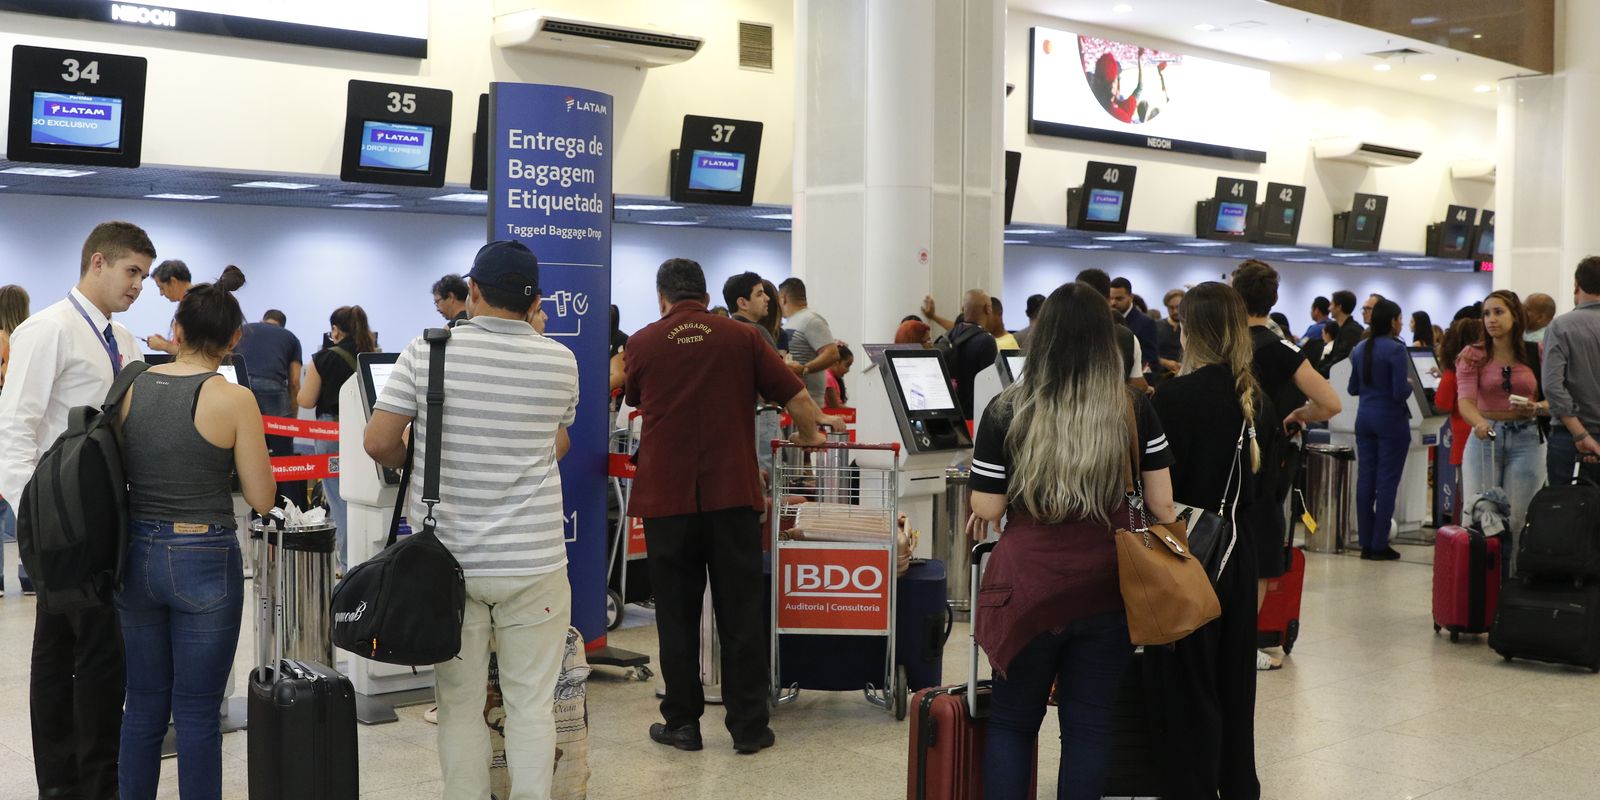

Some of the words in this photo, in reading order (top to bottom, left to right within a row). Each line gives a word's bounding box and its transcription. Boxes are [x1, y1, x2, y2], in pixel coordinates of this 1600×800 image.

[61, 58, 100, 84] 34
[387, 91, 417, 114] 35
[577, 101, 608, 115] LATAM
[62, 106, 105, 116] LATAM
[47, 119, 98, 129] EXCLUSIVO
[385, 133, 419, 142] LATAM
[711, 124, 736, 143] 37
[366, 144, 387, 152] DROP
[509, 129, 585, 158] Entrega
[589, 135, 603, 156] de
[1147, 136, 1172, 149] NEOOH
[708, 160, 735, 168] LATAM
[508, 159, 595, 187] Bagagem
[1103, 168, 1120, 183] 40
[1231, 182, 1245, 197] 41
[1279, 188, 1293, 202] 42
[508, 188, 603, 216] Etiquetada
[1364, 198, 1377, 211] 43
[1455, 209, 1467, 222] 44
[507, 224, 547, 238] Tagged
[549, 225, 586, 240] Baggage
[588, 228, 602, 241] Drop
[667, 322, 712, 340] CARREGADOR
[676, 335, 704, 345] PORTER
[785, 602, 825, 612] Auditoria
[831, 603, 880, 613] Consultoria
[555, 704, 577, 714] Ocean
